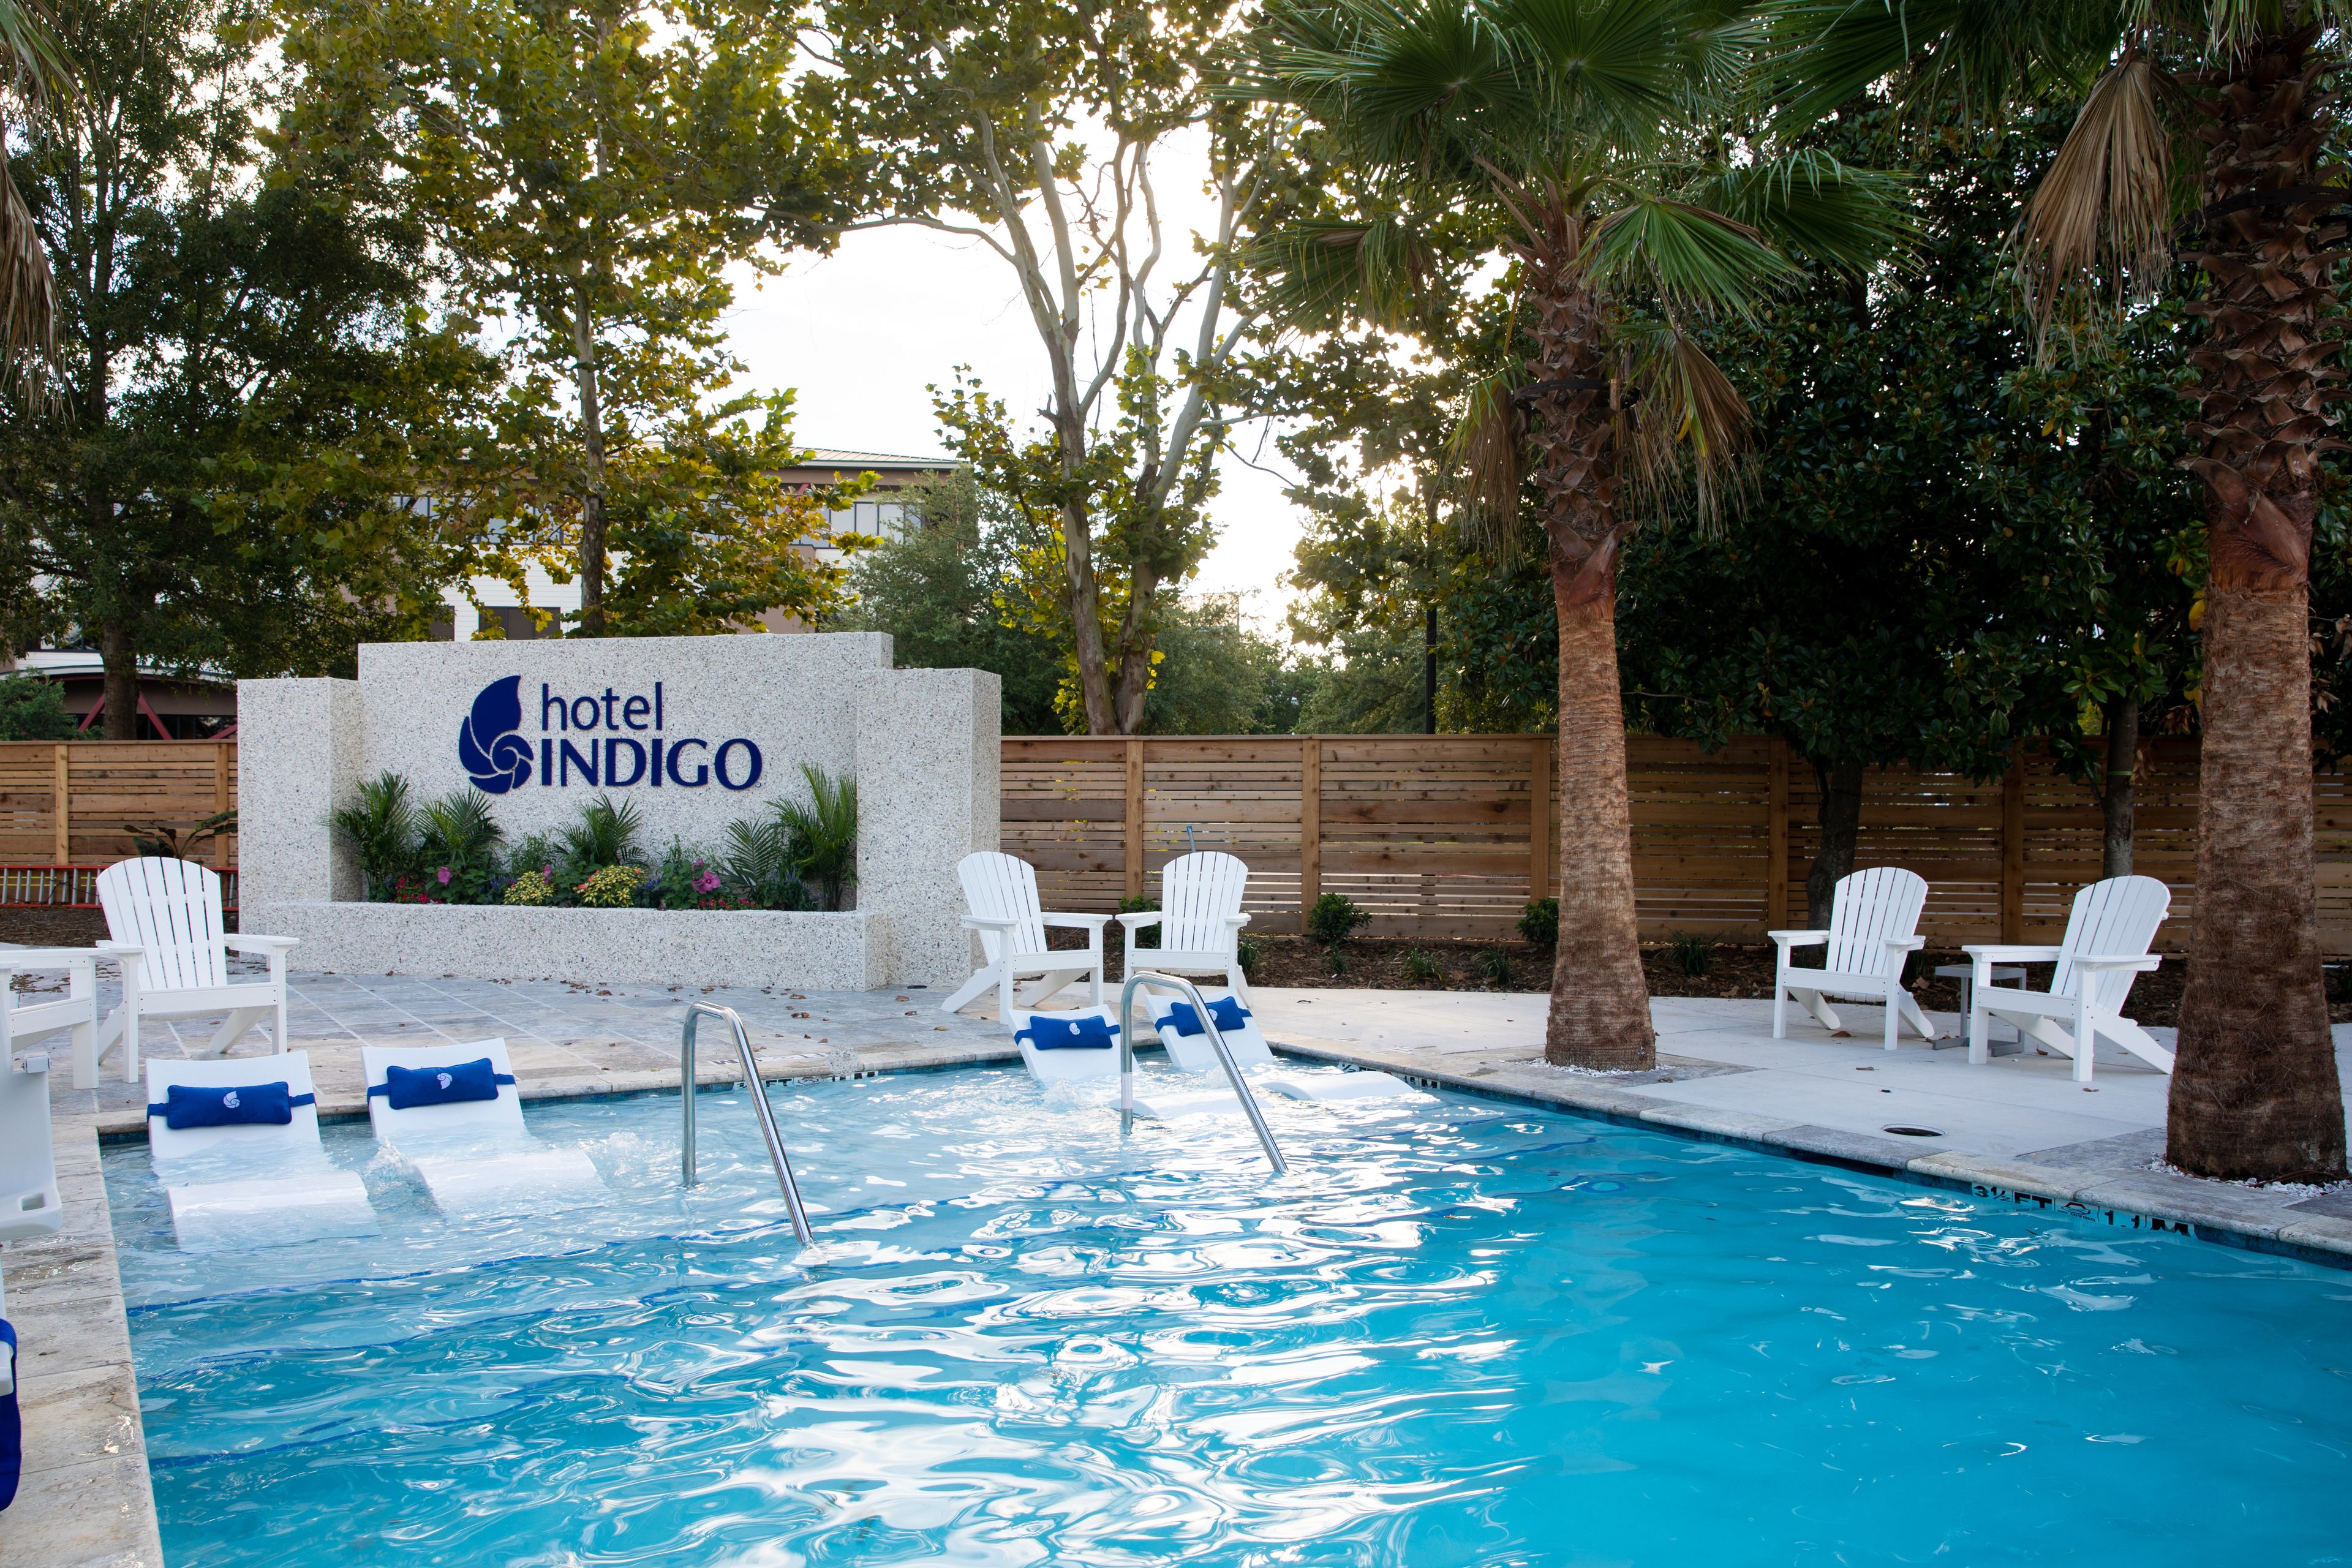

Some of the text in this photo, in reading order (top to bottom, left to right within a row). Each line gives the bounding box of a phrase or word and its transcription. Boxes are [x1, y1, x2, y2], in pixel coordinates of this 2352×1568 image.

[541, 682, 662, 731] hotel
[541, 737, 763, 790] INDIGO
[2014, 1192, 2052, 1208] FT
[2070, 1213, 2096, 1222] DIVING
